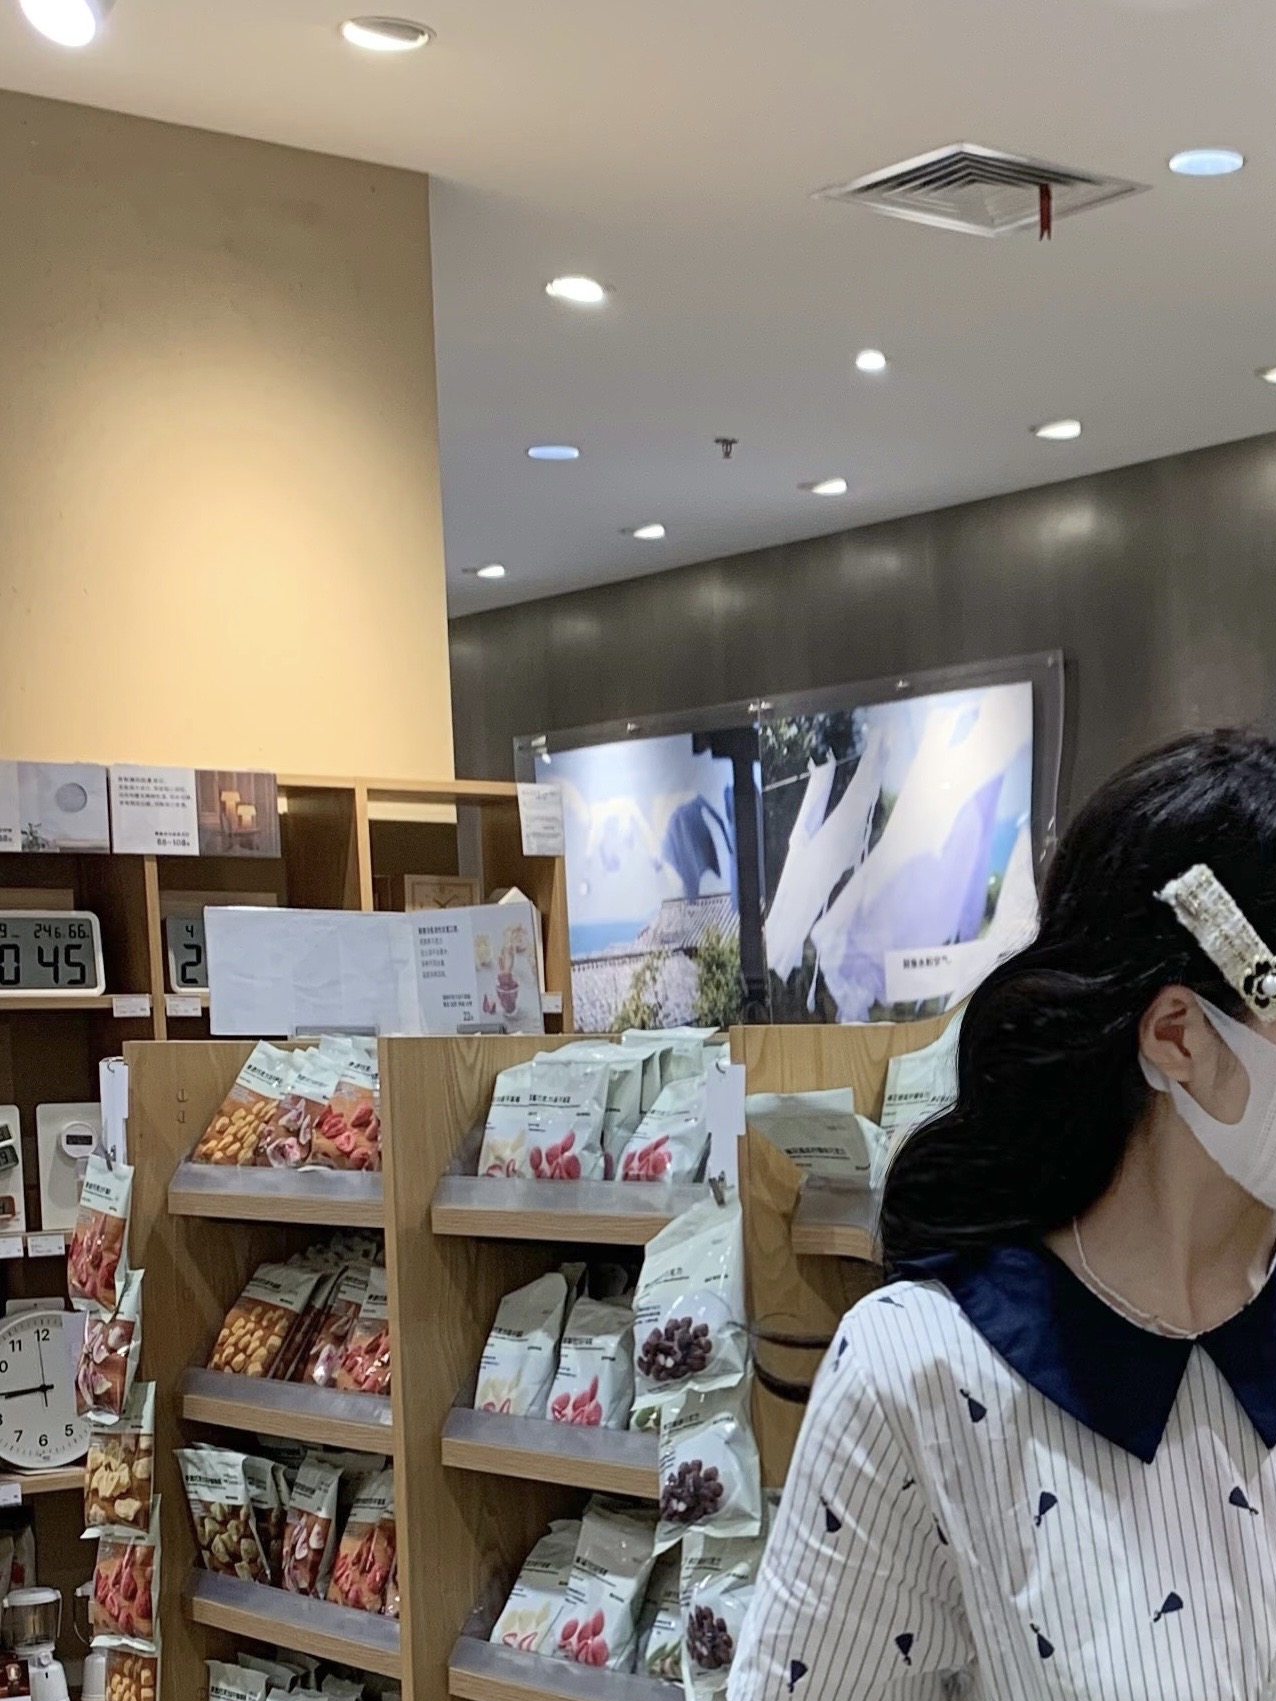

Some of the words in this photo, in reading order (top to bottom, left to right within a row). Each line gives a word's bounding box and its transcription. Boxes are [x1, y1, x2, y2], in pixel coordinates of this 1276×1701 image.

[37, 943, 86, 985] 45
[34, 1329, 50, 1342] 12
[9, 1340, 22, 1352] 11
[14, 1430, 23, 1442] 7
[65, 1424, 74, 1437] 5
[38, 1434, 48, 1447] 6
